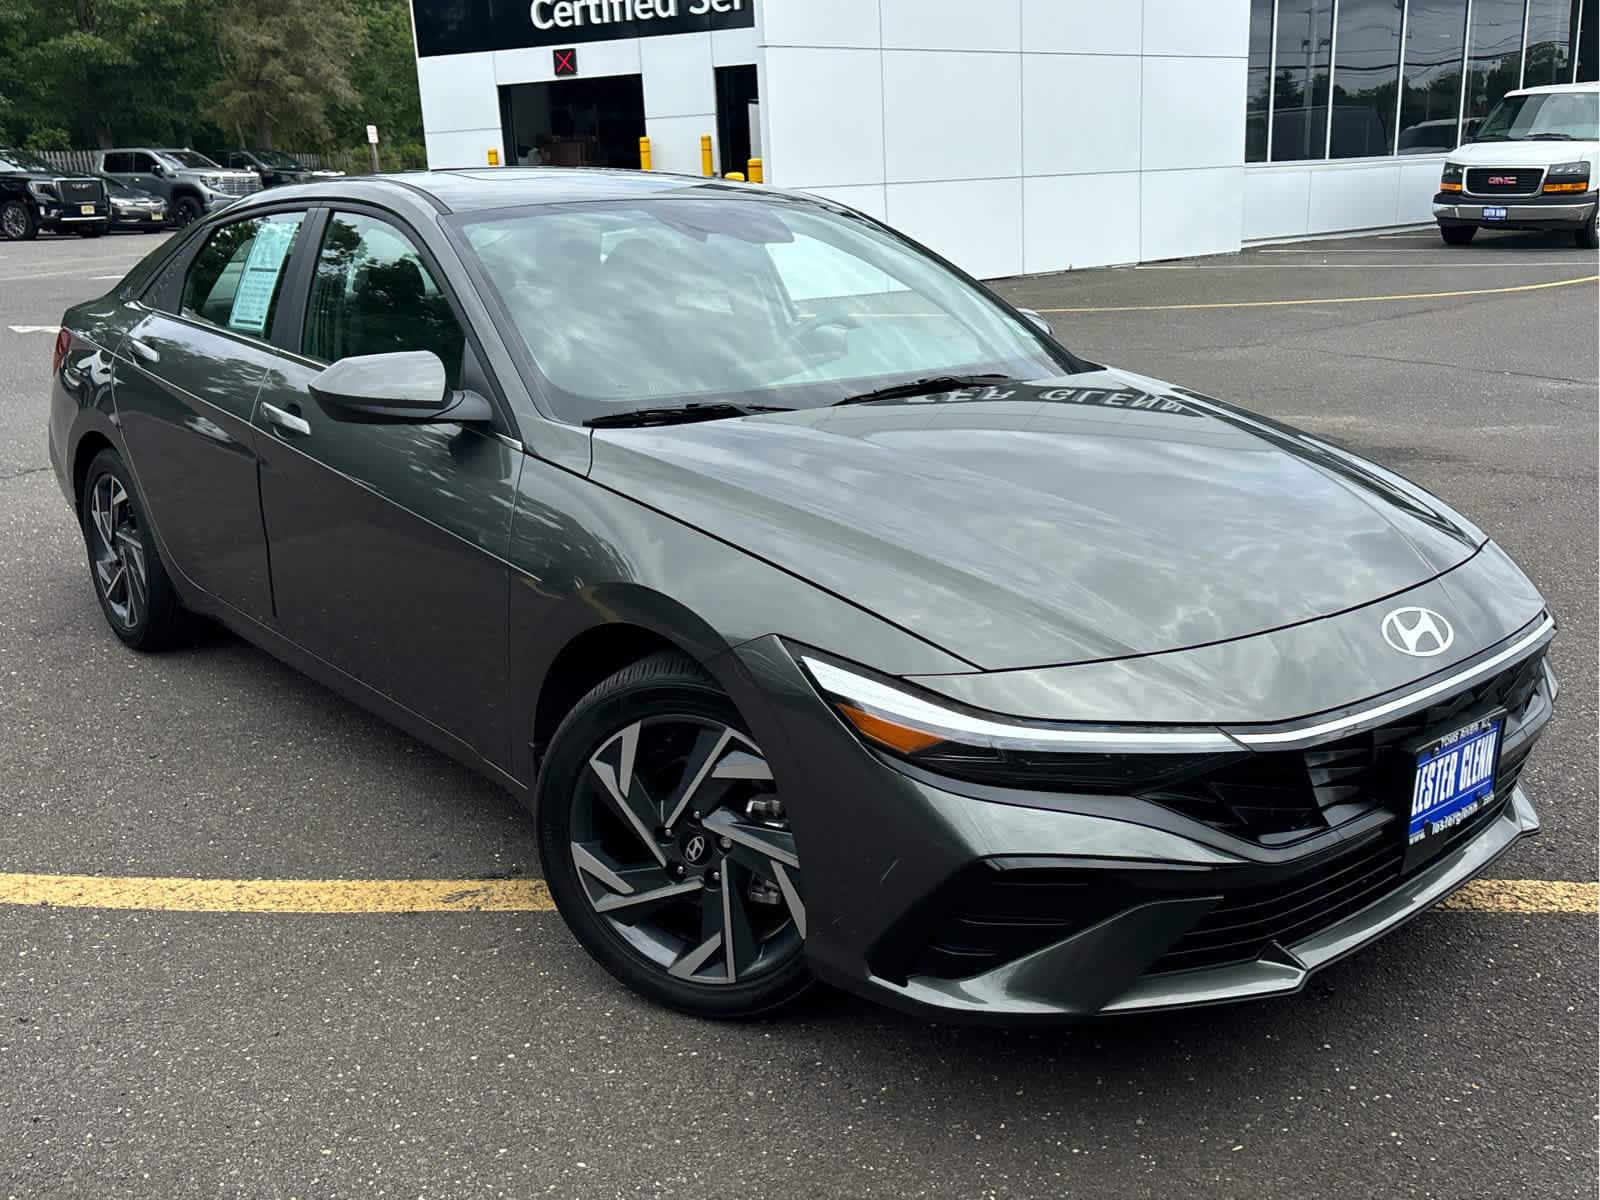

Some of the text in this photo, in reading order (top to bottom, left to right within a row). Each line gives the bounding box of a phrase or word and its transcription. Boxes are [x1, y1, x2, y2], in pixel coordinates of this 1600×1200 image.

[1488, 176, 1517, 184] GMC
[1411, 731, 1497, 817] LESTER GLENN
